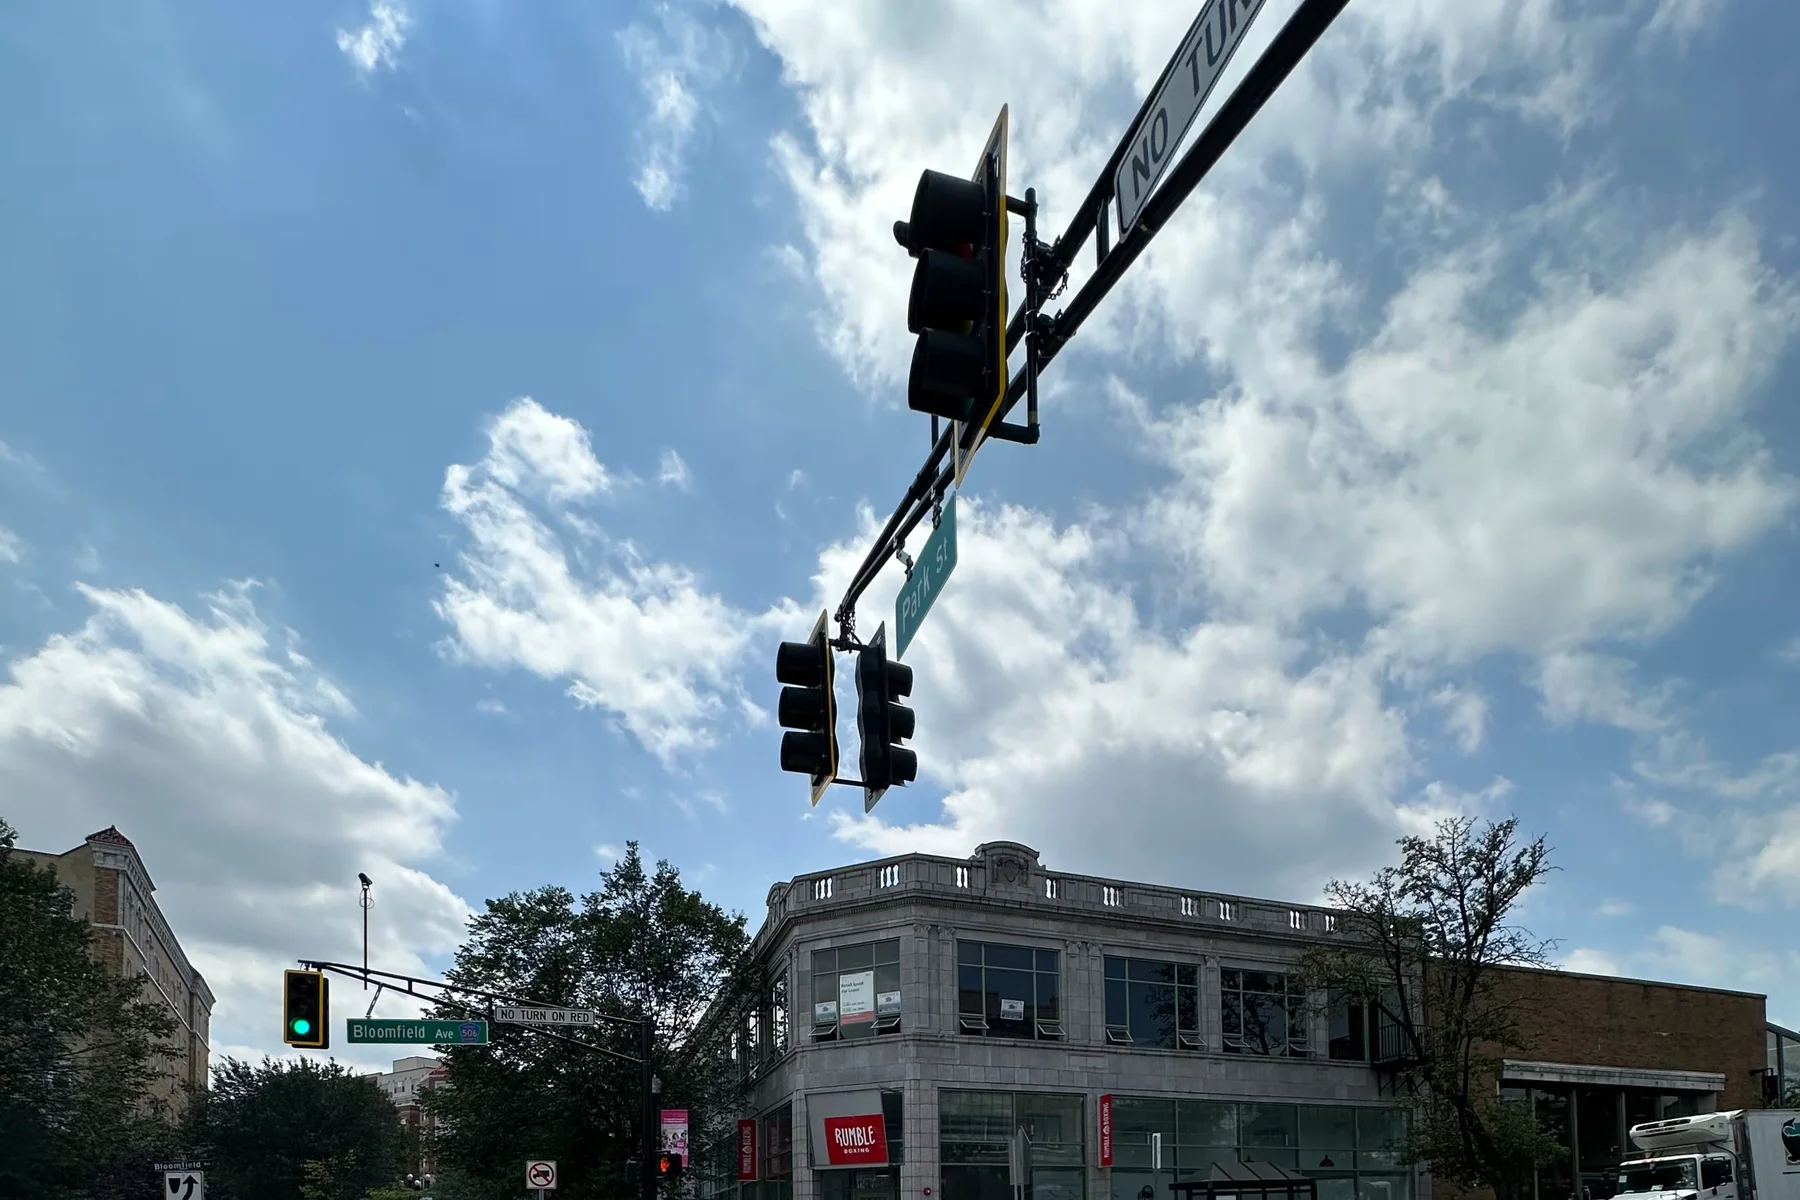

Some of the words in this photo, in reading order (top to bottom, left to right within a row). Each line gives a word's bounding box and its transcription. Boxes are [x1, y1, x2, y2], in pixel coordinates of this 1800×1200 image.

[1131, 107, 1168, 200] NO
[902, 565, 930, 633] Park
[936, 537, 948, 573] St
[501, 1009, 515, 1019] NO
[521, 1010, 546, 1020] TURN
[552, 1011, 565, 1021] ON
[571, 1012, 589, 1022] RED
[353, 1024, 425, 1039] Bloomfield
[435, 1029, 453, 1039] Ave
[462, 1029, 478, 1038] 506
[743, 1126, 751, 1145] BOXING
[835, 1126, 875, 1147] RUMBLE
[154, 1162, 201, 1170] Bloomfield
[743, 1154, 751, 1173] RUMBLE
